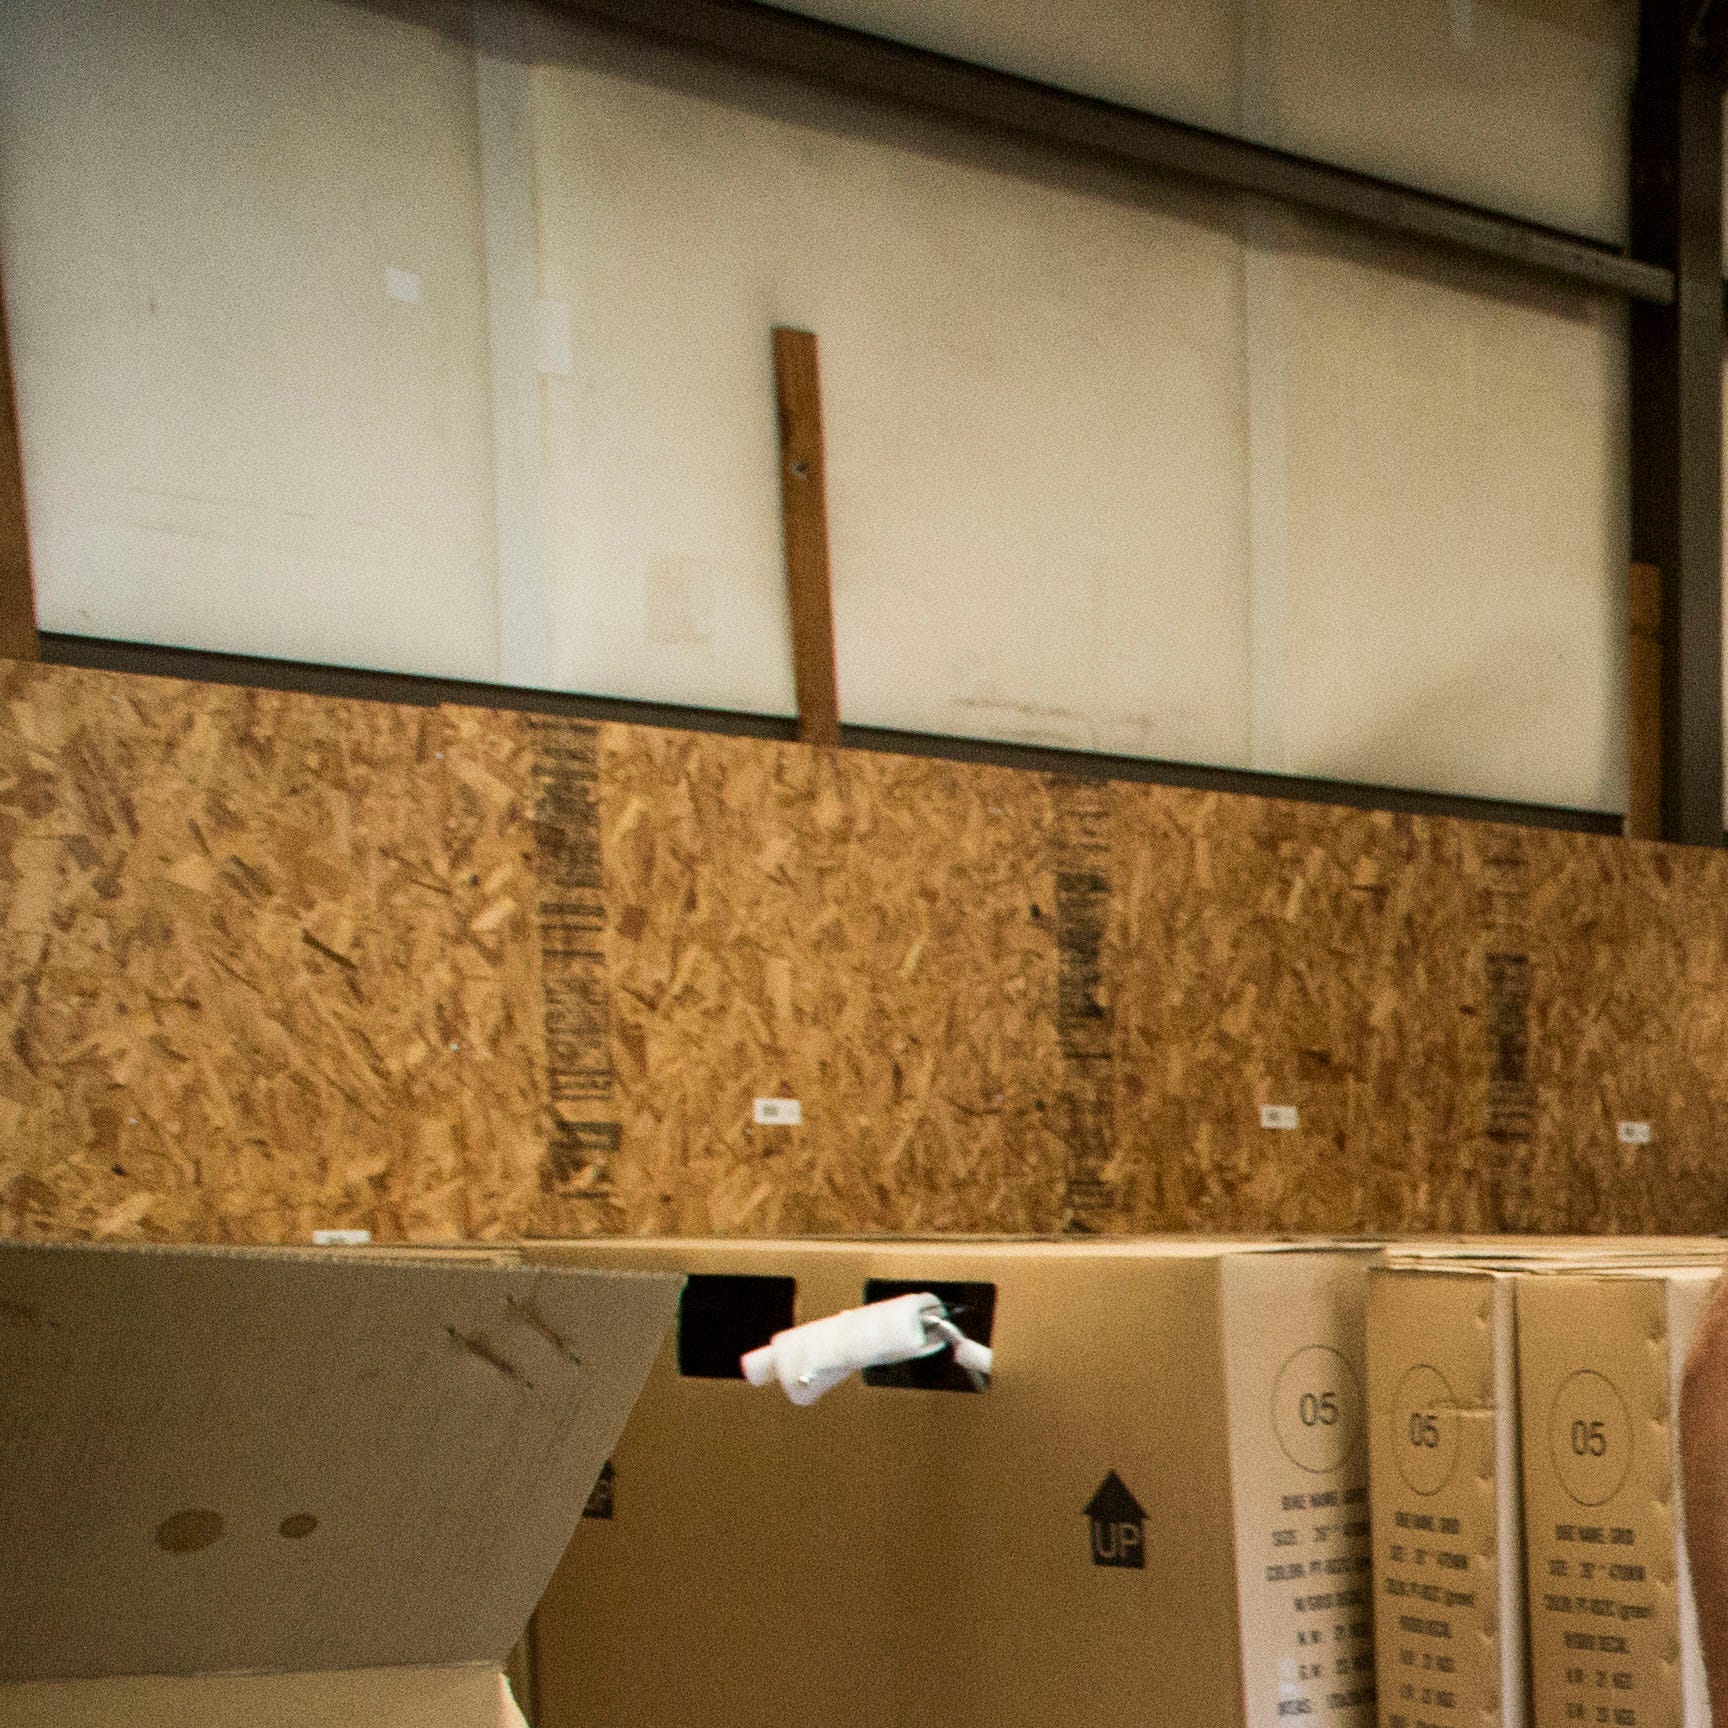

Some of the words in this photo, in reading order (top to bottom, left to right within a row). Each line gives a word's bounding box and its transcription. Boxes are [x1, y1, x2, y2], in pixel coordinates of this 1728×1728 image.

[1299, 1391, 1339, 1427] 05
[1409, 1412, 1440, 1449] 05
[1571, 1420, 1607, 1457] 05
[1094, 1521, 1143, 1559] UP
